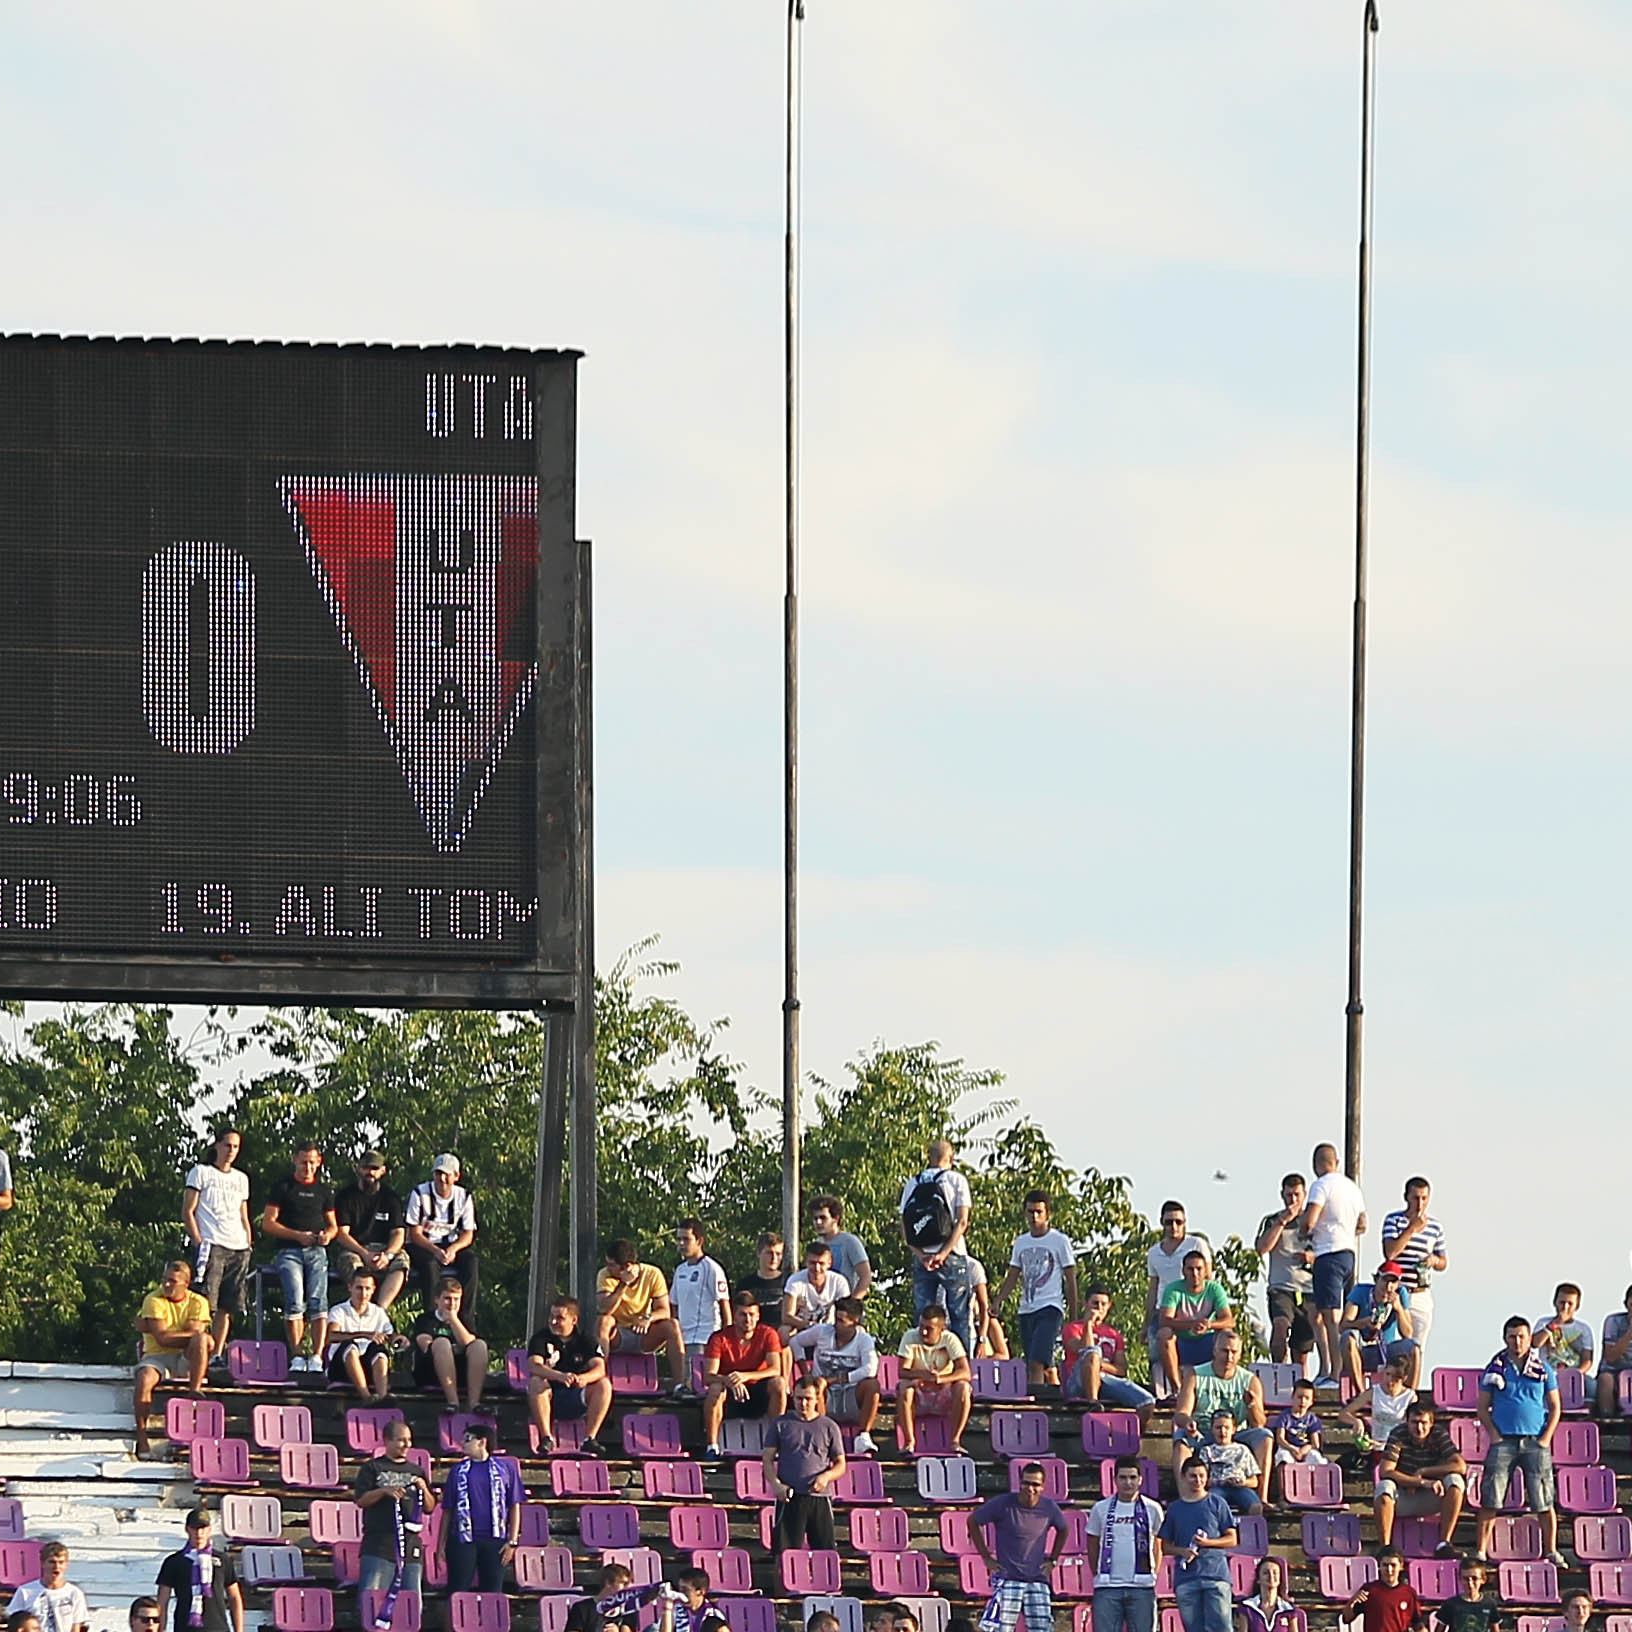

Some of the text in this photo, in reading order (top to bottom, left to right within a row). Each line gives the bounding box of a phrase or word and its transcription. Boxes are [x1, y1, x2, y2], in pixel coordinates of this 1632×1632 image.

[425, 373, 534, 441] UTA
[142, 540, 257, 755] 0
[160, 882, 251, 935] 19.
[274, 885, 384, 937] ALI
